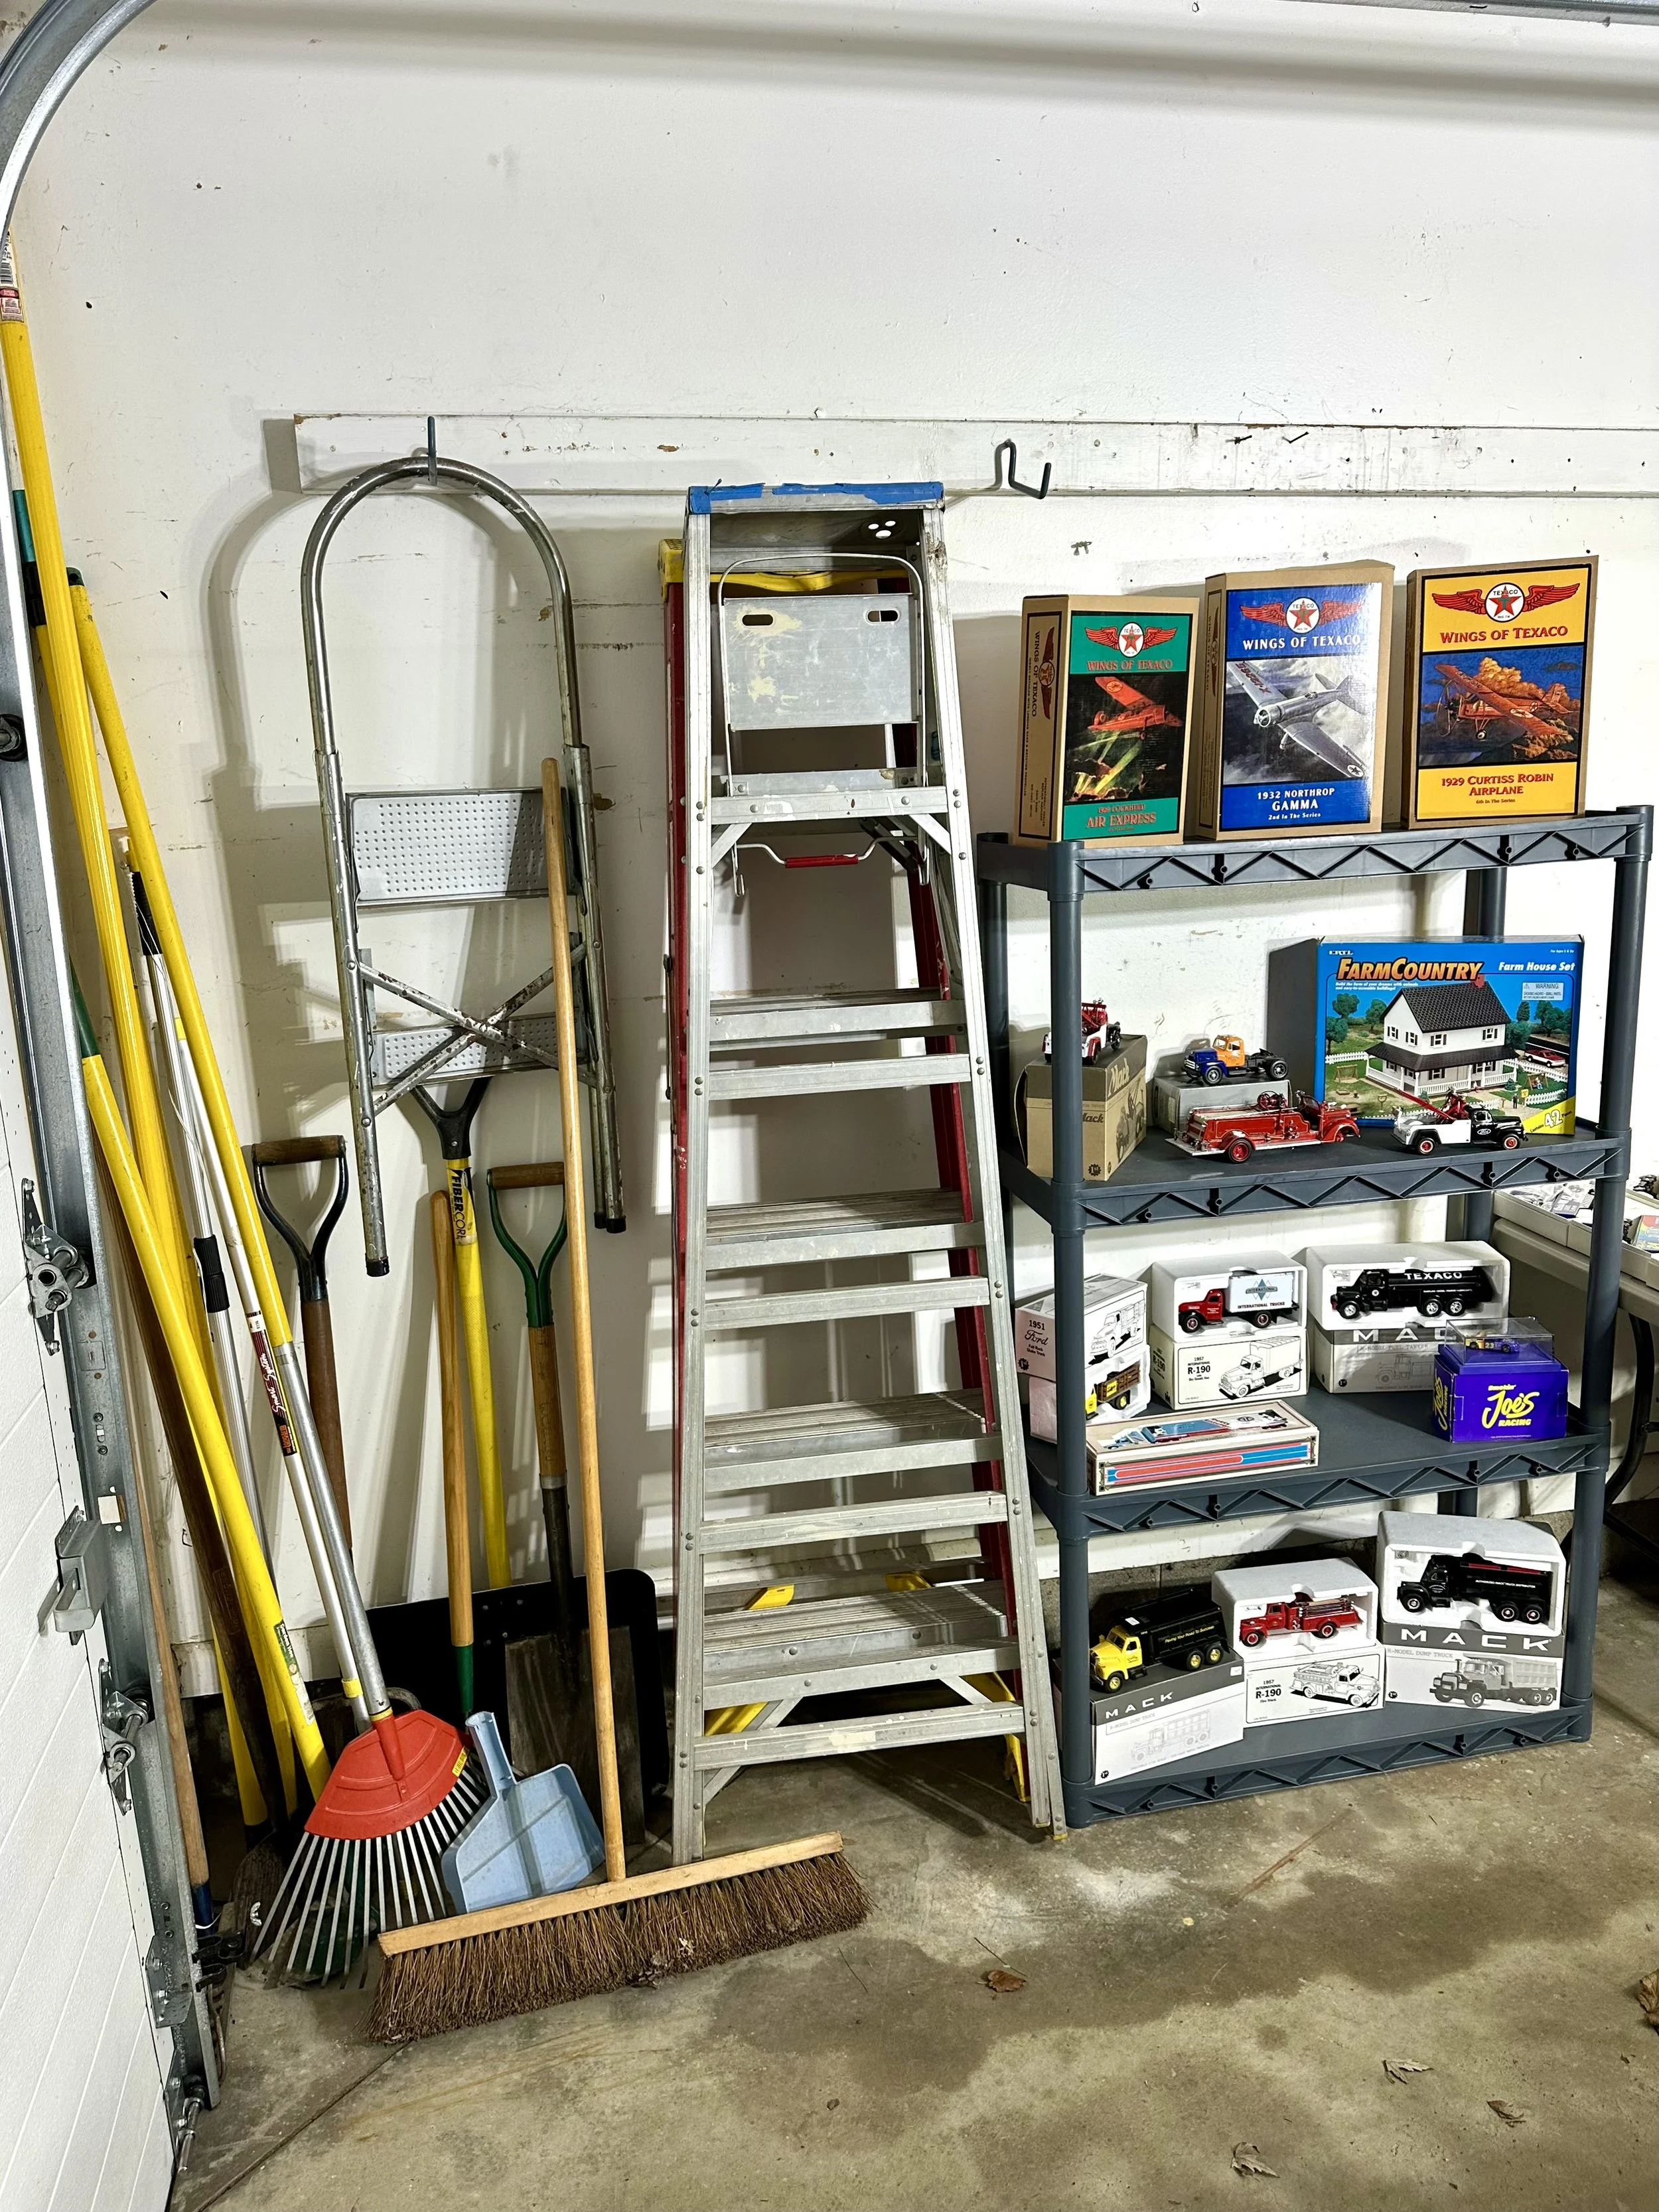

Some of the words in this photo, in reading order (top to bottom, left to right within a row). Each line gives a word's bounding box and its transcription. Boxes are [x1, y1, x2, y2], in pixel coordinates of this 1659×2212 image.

[1440, 631, 1486, 644] WINGS
[1490, 629, 1510, 640] OF
[1512, 625, 1568, 638] TEXACO
[1243, 638, 1285, 650] WINGS
[1291, 637, 1307, 648] OF
[1312, 634, 1361, 646] TEXACO
[1087, 660, 1118, 671] WINGS
[1121, 660, 1133, 670] OF
[1137, 659, 1172, 670] TEXACO
[1033, 666, 1039, 680] OF
[1441, 777, 1465, 787] 1929
[1467, 775, 1514, 785] CURTISS
[1518, 773, 1553, 782] ROBIN
[1258, 791, 1281, 800] 1932
[1284, 788, 1335, 798] NORTHROP
[1469, 786, 1524, 796] AIRPLANE
[1271, 798, 1319, 811] GAMMA
[1087, 816, 1106, 828] AIR
[1110, 812, 1156, 827] EXPRESS
[1498, 962, 1524, 971] Farm
[1526, 962, 1557, 971] House
[1558, 962, 1575, 971] Set
[1108, 1058, 1129, 1097] Mack
[1083, 1112, 1104, 1123] ack
[1544, 1109, 1563, 1128] 42
[1530, 1124, 1544, 1133] Contains
[1029, 1320, 1045, 1331] 1951
[1025, 1329, 1048, 1345] Ford
[1353, 1328, 1457, 1342] MAC
[261, 1353, 278, 1382] System
[1188, 1365, 1210, 1374] R-190
[268, 1386, 286, 1413] Smart
[1482, 1390, 1540, 1429] Joe's
[1401, 1629, 1550, 1651] MACK
[1256, 1688, 1281, 1699] R-190
[1106, 1692, 1174, 1720] MACK
[1141, 1712, 1156, 1722] TRUCK
